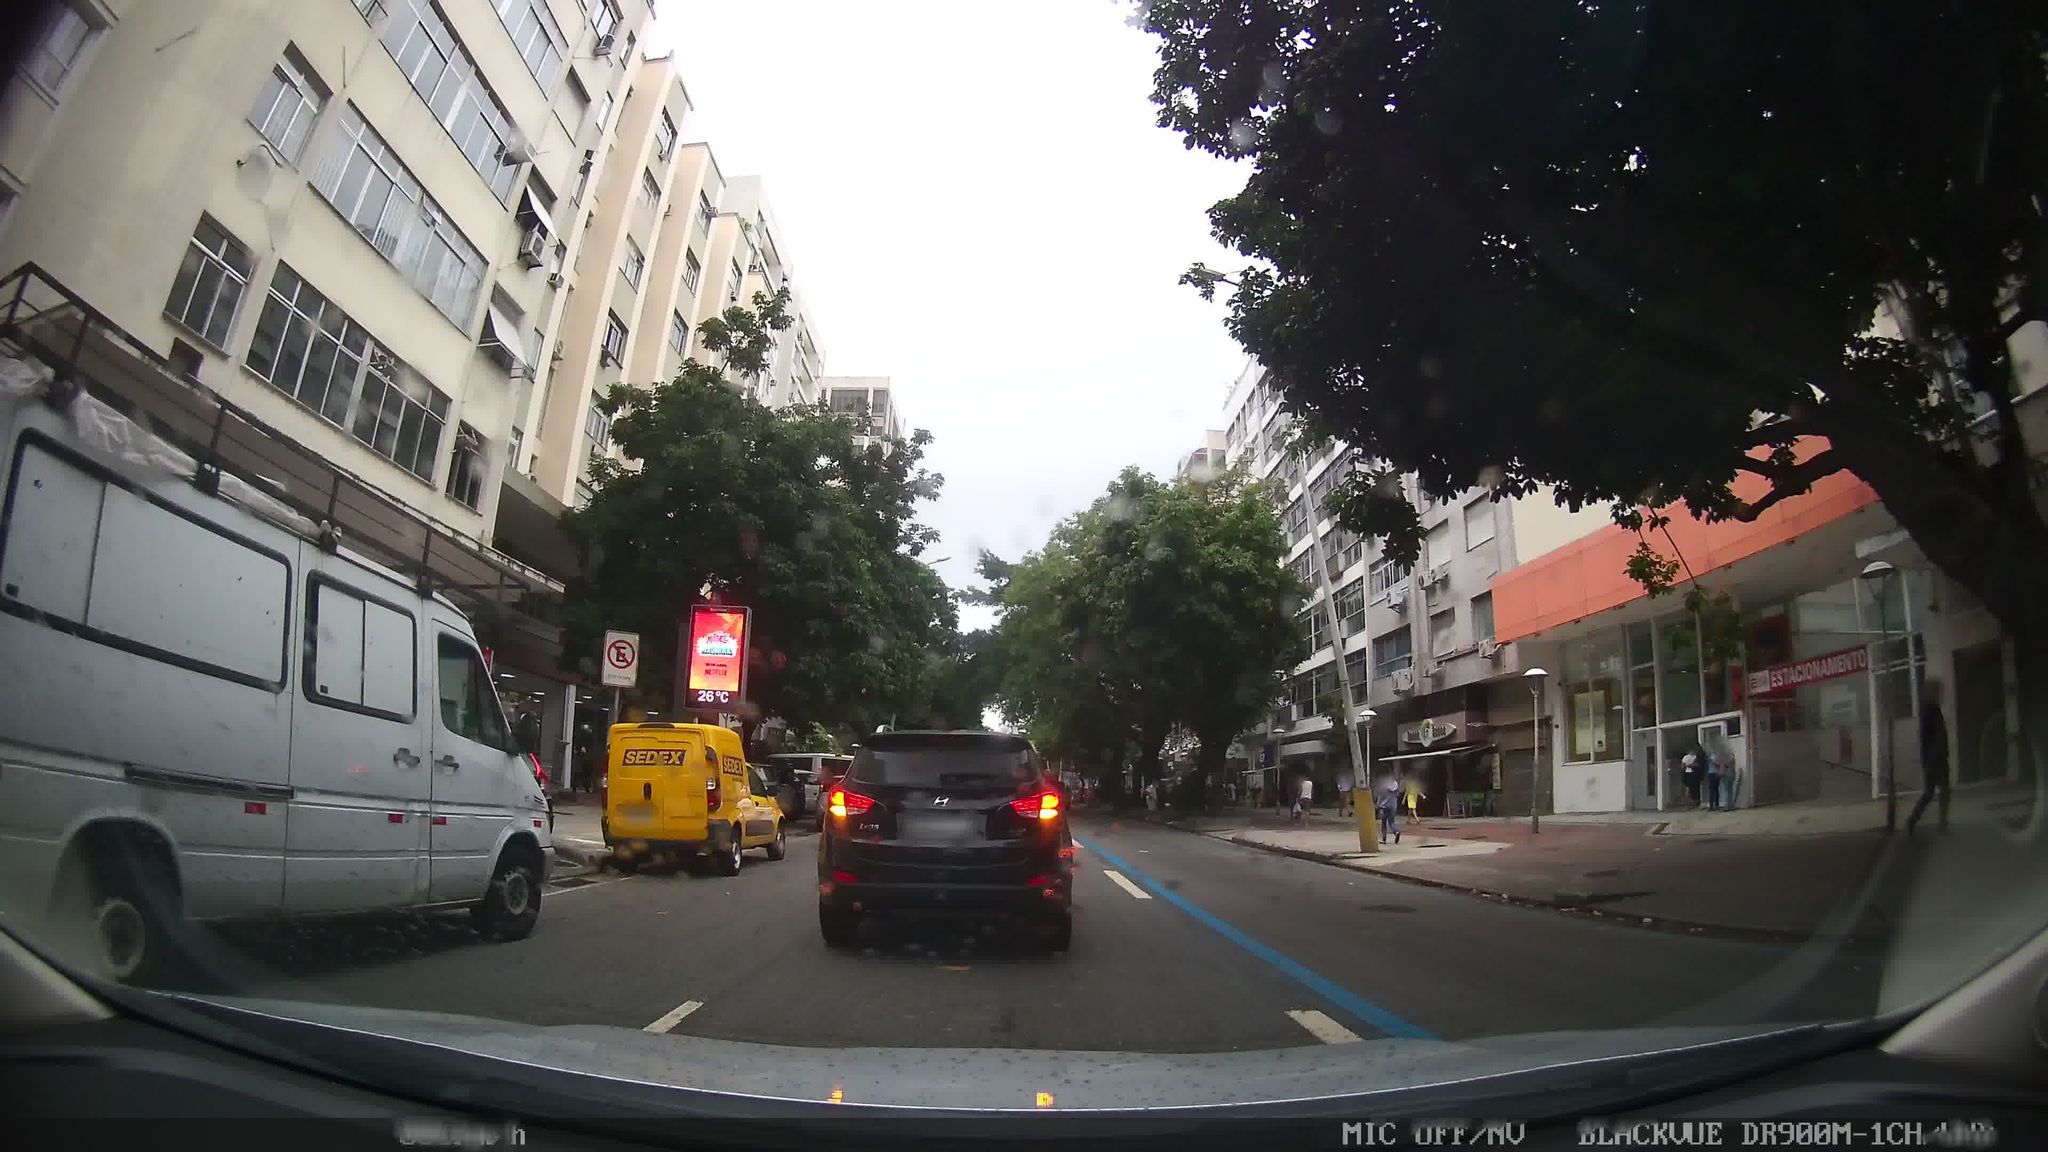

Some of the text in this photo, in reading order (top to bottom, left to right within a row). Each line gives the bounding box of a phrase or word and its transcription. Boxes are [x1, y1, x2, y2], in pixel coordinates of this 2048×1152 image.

[1771, 650, 1866, 687] ESTACIONAMENTO
[698, 690, 729, 703] 26°C
[624, 750, 682, 765] SEDEX
[723, 757, 743, 775] SEDEX
